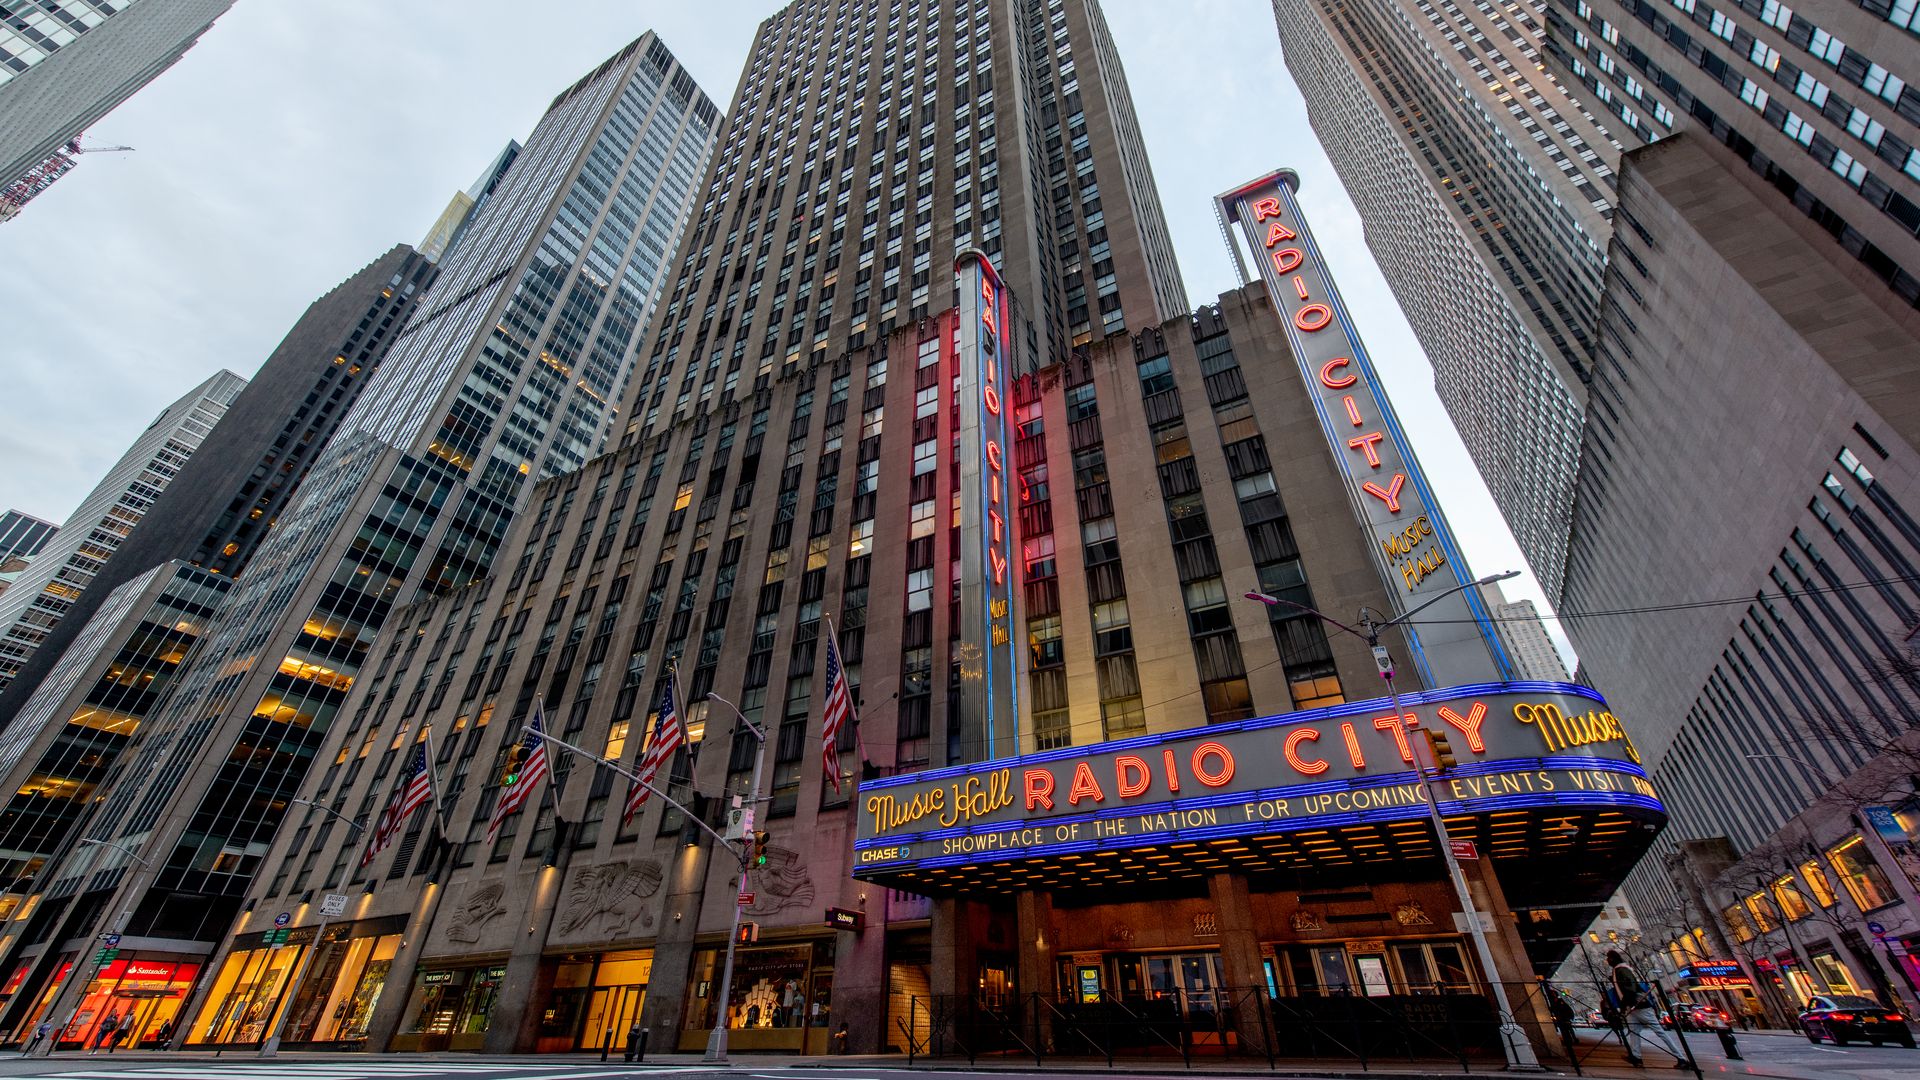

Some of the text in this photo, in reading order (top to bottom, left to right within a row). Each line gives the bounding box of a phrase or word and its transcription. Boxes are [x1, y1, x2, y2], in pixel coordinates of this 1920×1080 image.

[1252, 197, 1405, 513] RADIO CITY
[982, 277, 1006, 586] RADIO CITY
[1382, 516, 1432, 566] MUSIC
[1399, 546, 1446, 592] HALL
[867, 788, 945, 834] Music
[939, 767, 1014, 827] Hall
[1023, 741, 1236, 812] RADIO
[1284, 701, 1488, 776] CITY
[942, 828, 1044, 855] SHOWPLACE
[1055, 823, 1080, 842] OF
[1093, 818, 1128, 837] THE
[1141, 808, 1218, 833] NATION
[1245, 799, 1290, 821] FOR
[1451, 771, 1554, 799] EVENTS
[1568, 771, 1624, 791] VISIT
[861, 847, 899, 862] CHASE
[137, 967, 169, 975] Santander
[1700, 976, 1730, 987] NBC
